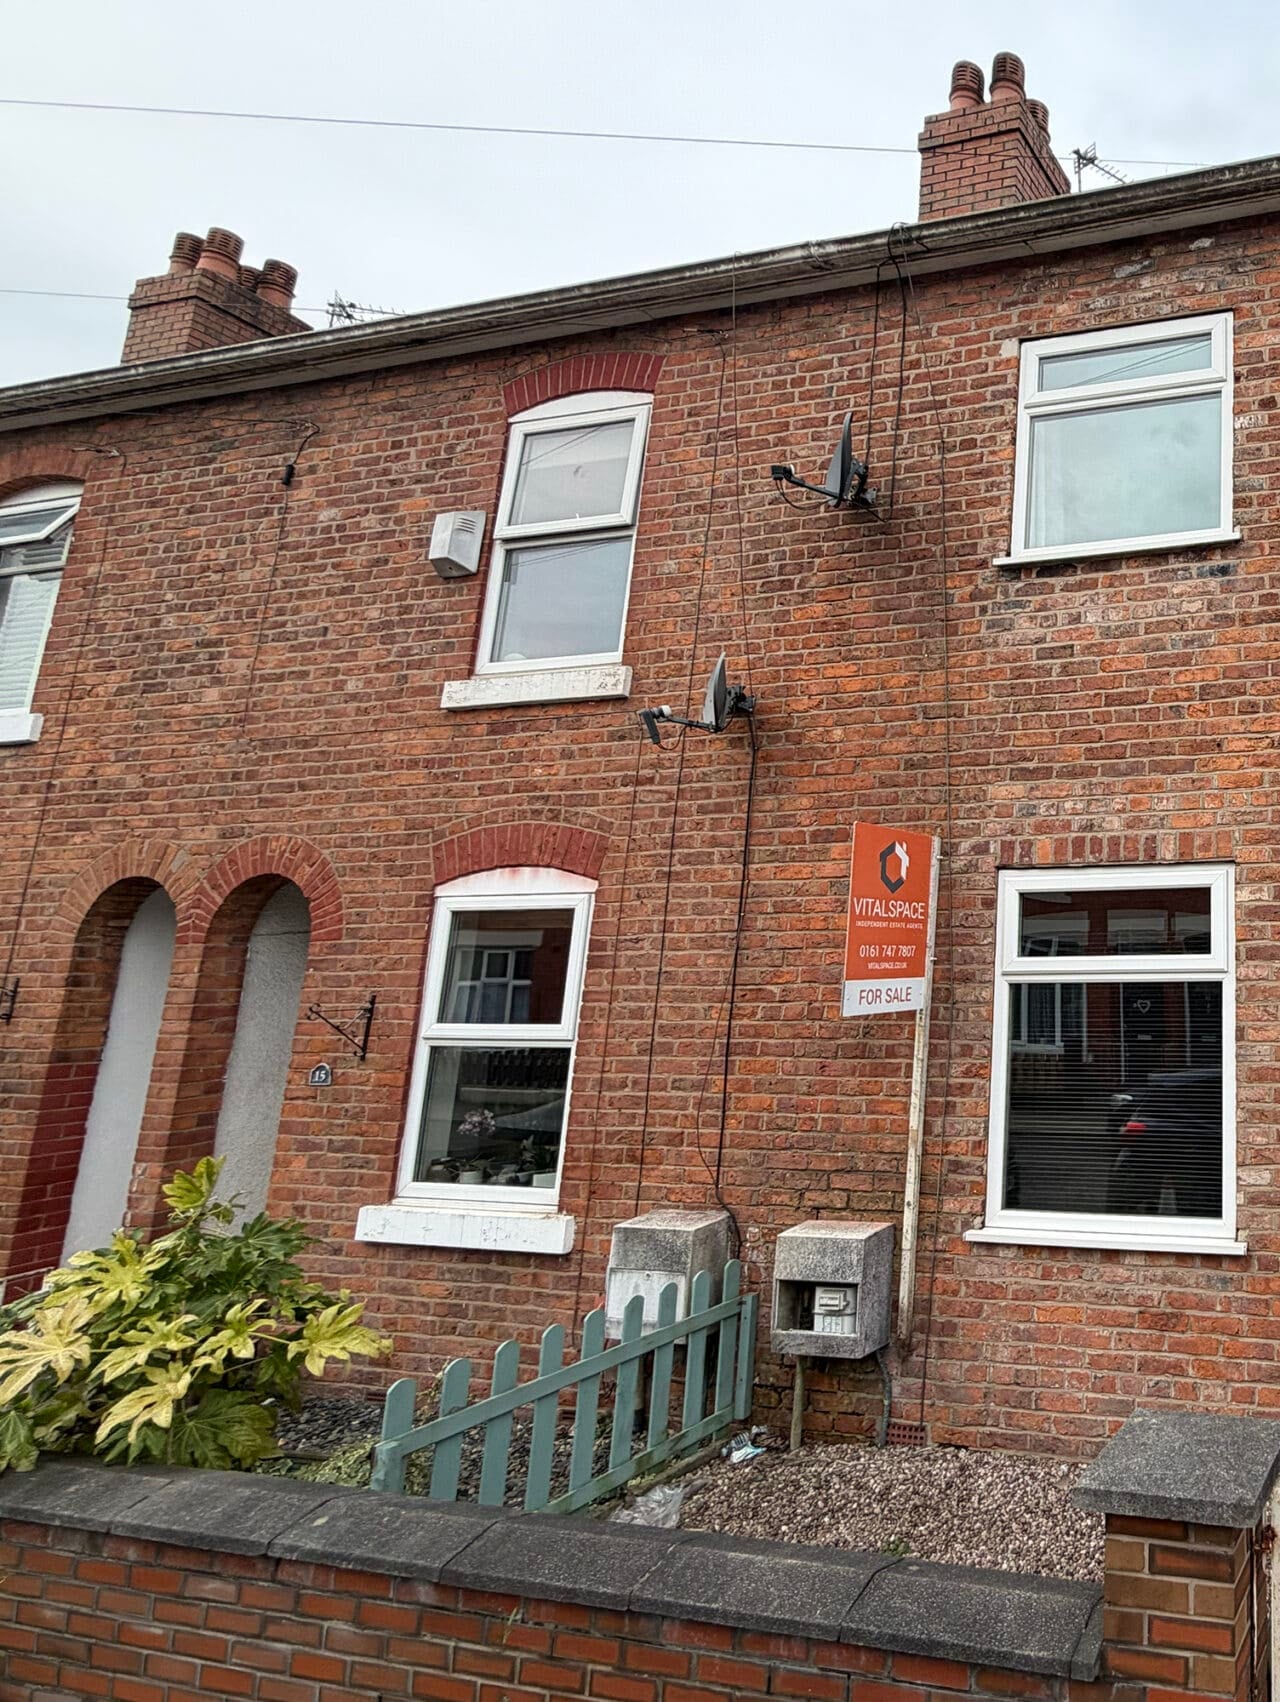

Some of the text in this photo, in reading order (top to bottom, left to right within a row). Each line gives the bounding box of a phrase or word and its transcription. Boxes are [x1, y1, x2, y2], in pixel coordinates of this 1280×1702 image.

[853, 897, 925, 919] VITALSPACE
[855, 920, 888, 928] INDEPENDENT
[889, 921, 906, 929] ESTATE
[859, 945, 916, 957] 0161 747 7807
[858, 986, 913, 1005] FOR SALE
[314, 1070, 327, 1082] 15
